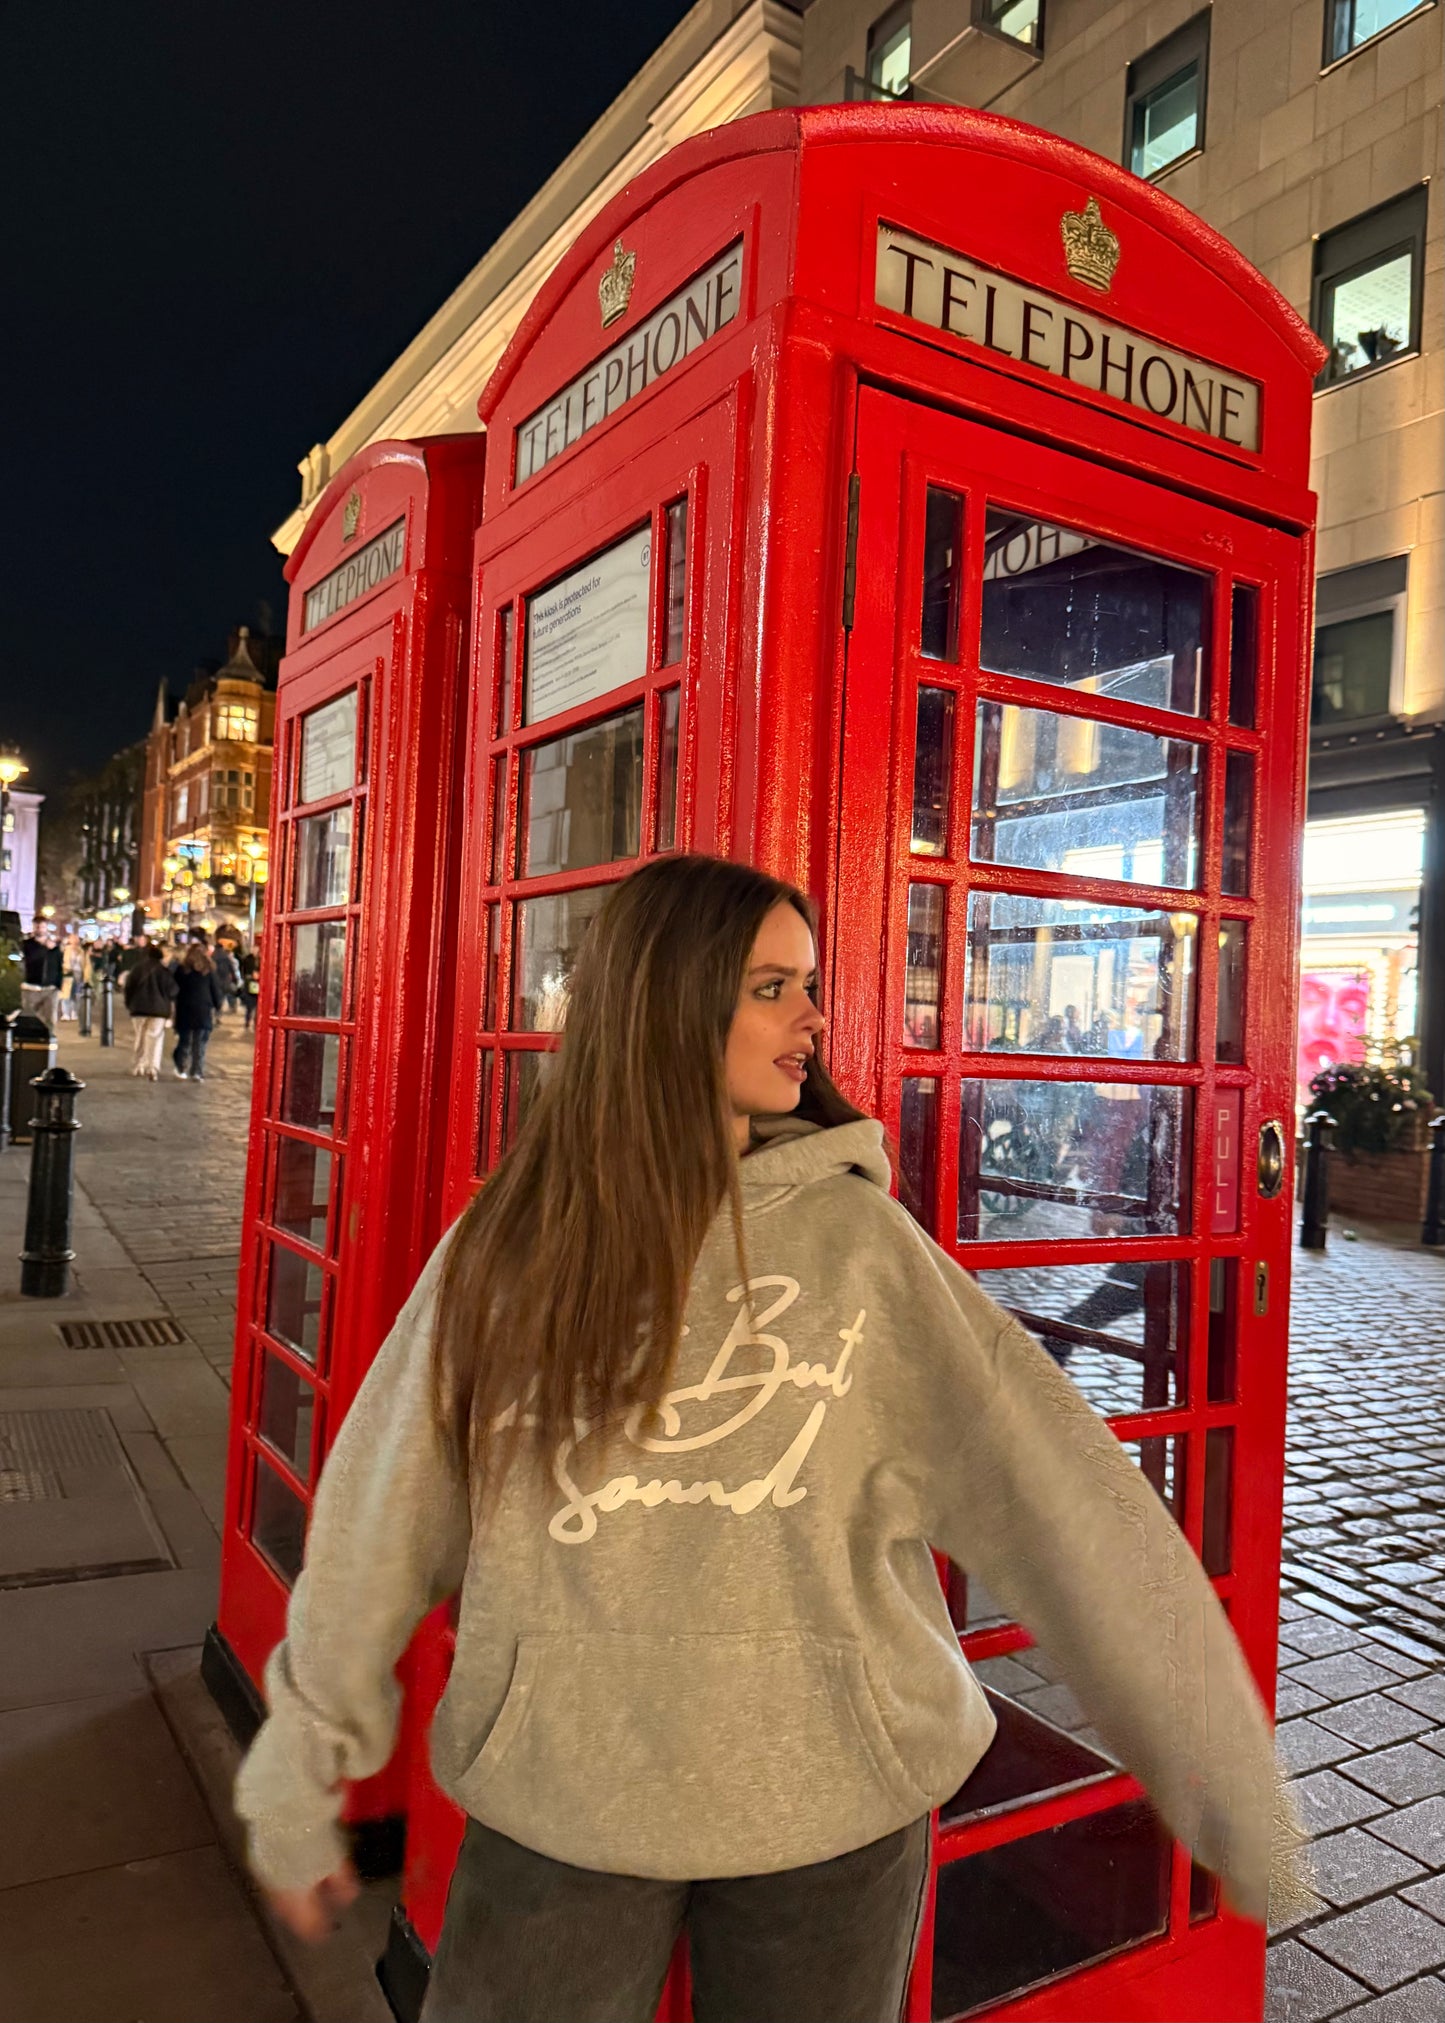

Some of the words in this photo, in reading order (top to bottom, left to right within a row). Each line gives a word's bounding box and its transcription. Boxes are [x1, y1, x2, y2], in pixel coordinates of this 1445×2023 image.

[525, 259, 738, 476] TELEPHONE
[887, 244, 1244, 446] TELEPHONE
[309, 527, 404, 629] TELEPHONE
[533, 611, 544, 624] This
[544, 602, 559, 619] kiosk
[563, 578, 592, 610] protected
[592, 576, 601, 590] for
[549, 604, 582, 634] generations
[1216, 1109, 1230, 1214] PULL
